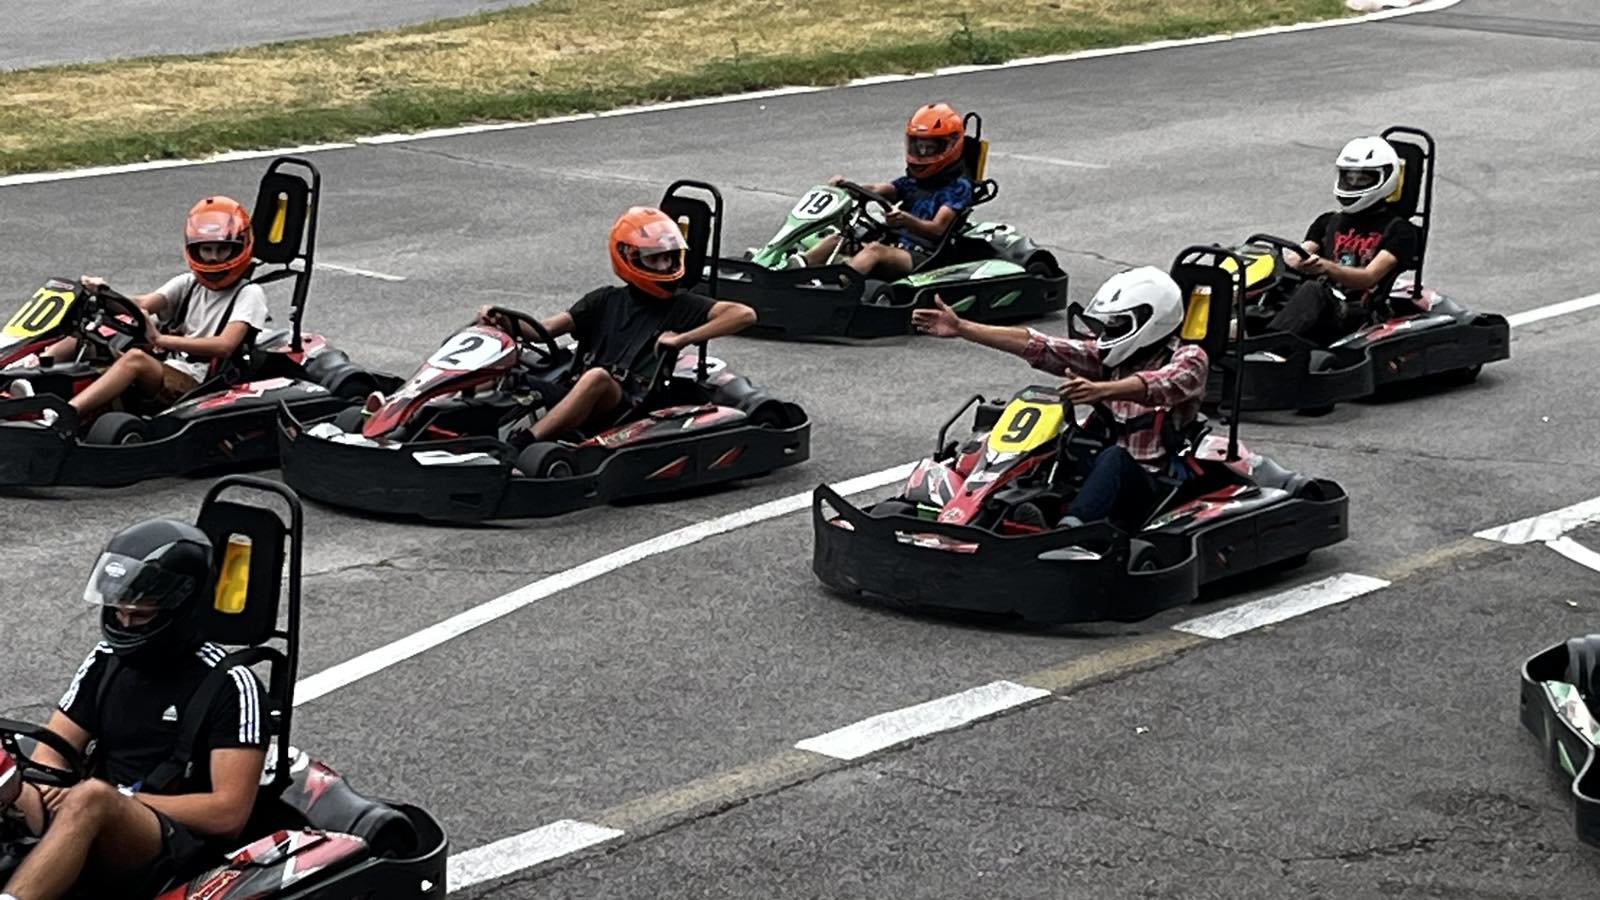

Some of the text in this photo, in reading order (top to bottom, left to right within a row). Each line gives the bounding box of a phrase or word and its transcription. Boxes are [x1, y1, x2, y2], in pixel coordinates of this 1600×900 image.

[799, 192, 833, 215] 19
[10, 293, 65, 332] 10
[438, 336, 485, 366] 2
[1000, 406, 1042, 443] 9
